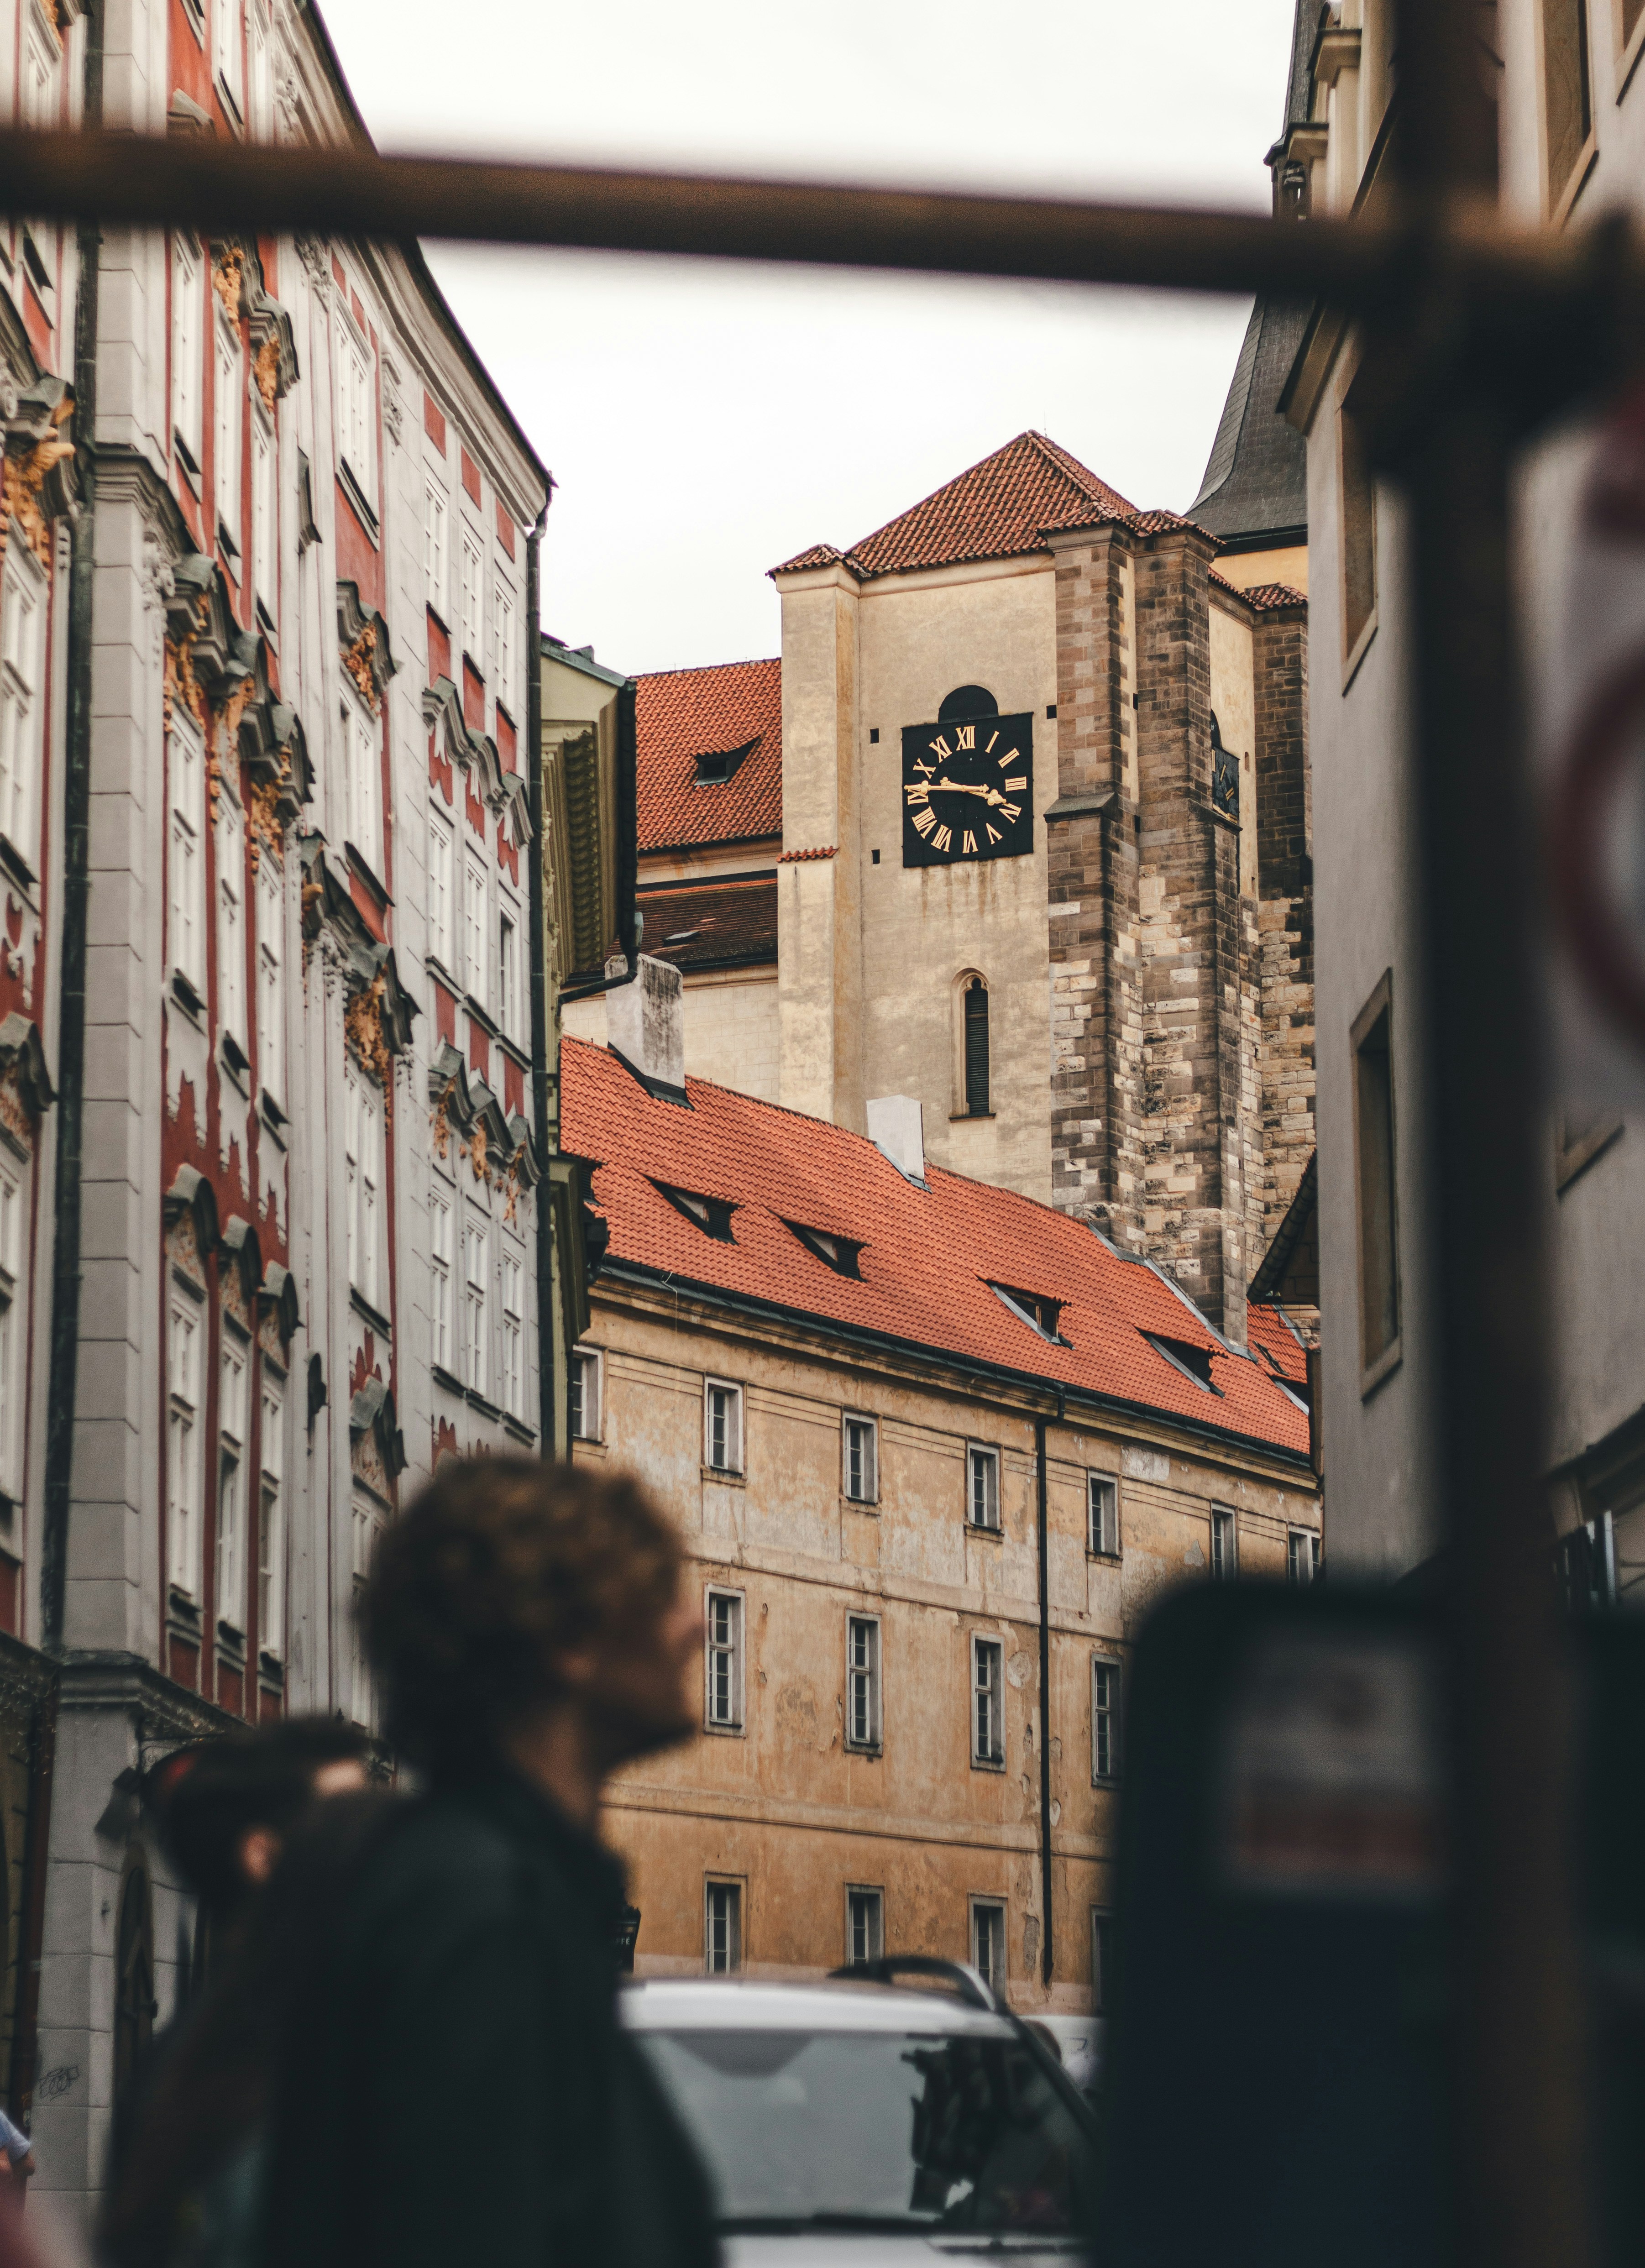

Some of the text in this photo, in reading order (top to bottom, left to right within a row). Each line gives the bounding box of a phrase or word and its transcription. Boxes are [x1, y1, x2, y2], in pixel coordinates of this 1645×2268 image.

[928, 735, 953, 763] XI
[955, 725, 976, 751] XII
[985, 731, 1000, 754] I
[912, 758, 936, 779] X
[998, 748, 1020, 769] II
[1005, 776, 1027, 792] III
[907, 788, 929, 806] IX
[912, 806, 938, 839] VIII
[999, 802, 1022, 824] IV
[930, 824, 952, 852] VII
[962, 830, 979, 854] VI
[986, 822, 1003, 845] V
